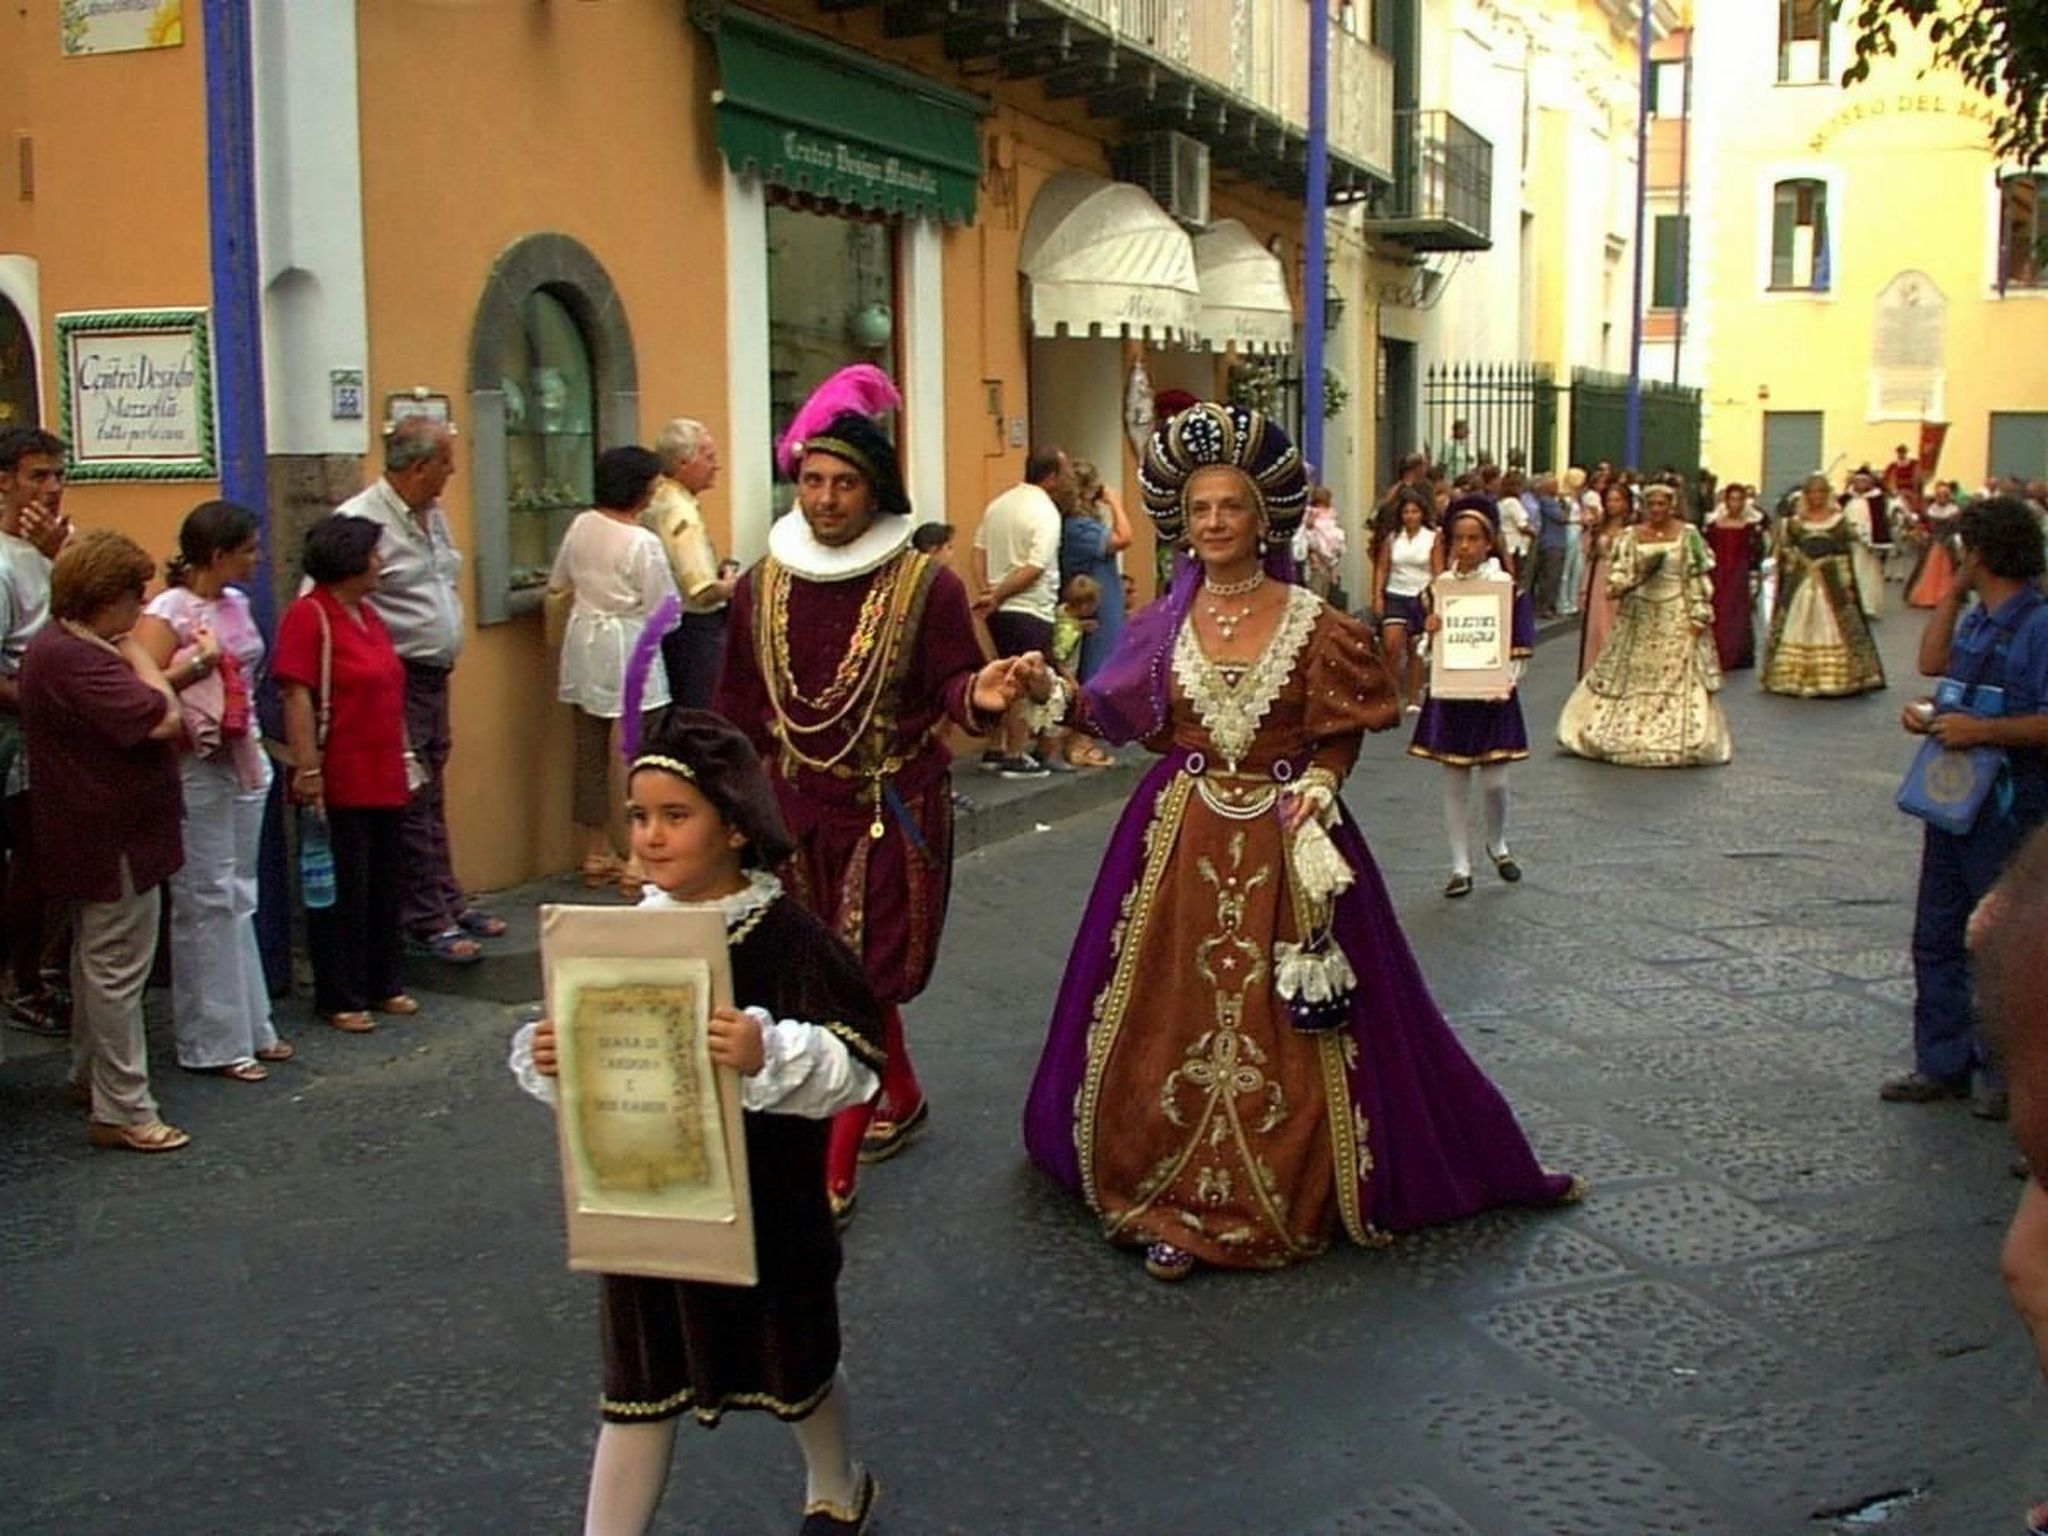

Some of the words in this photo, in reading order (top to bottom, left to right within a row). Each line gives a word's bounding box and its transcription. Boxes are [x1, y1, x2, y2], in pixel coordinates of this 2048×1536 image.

[1897, 95, 1947, 112] DEL
[79, 353, 136, 391] Centro
[137, 350, 194, 391] Design
